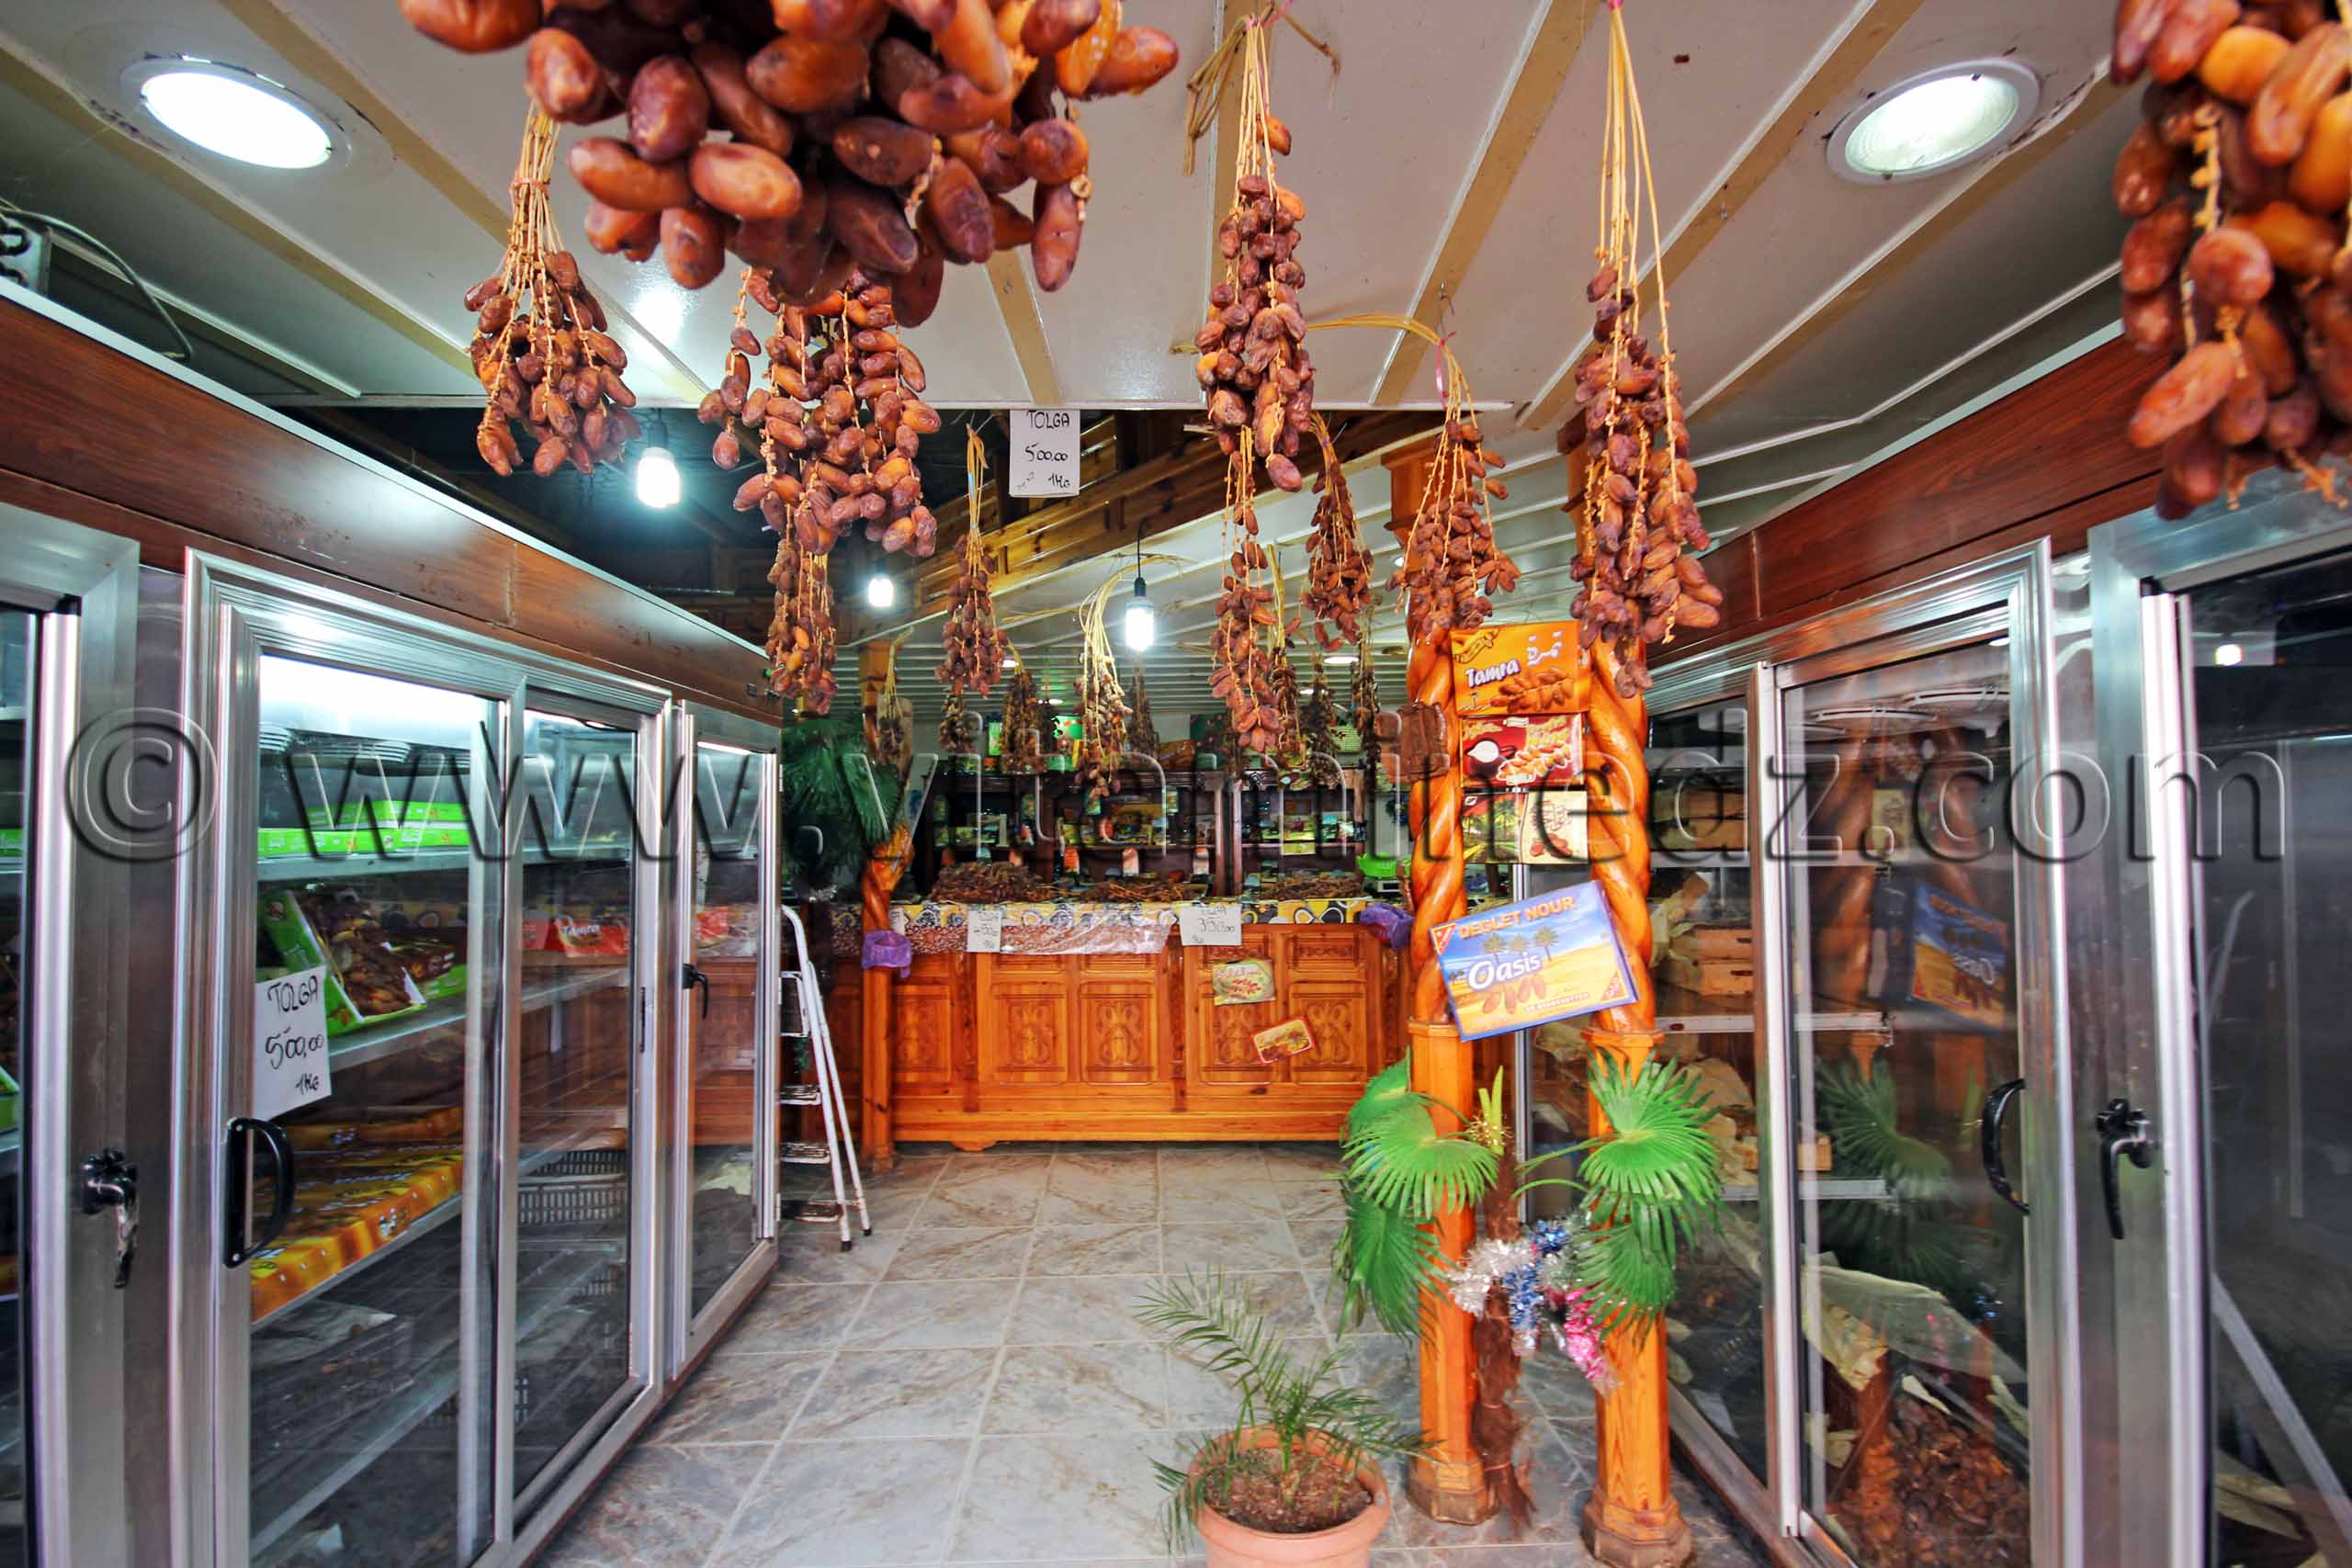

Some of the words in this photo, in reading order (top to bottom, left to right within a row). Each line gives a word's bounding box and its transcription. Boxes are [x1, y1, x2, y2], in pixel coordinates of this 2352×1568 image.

[1025, 410, 1070, 429] TOLGA
[1464, 659, 1522, 688] Tamra
[1457, 908, 1523, 941] DEGLET
[1524, 895, 1577, 921] NOUR
[1467, 953, 1544, 991] Oasis
[266, 976, 319, 1013] TOLGA
